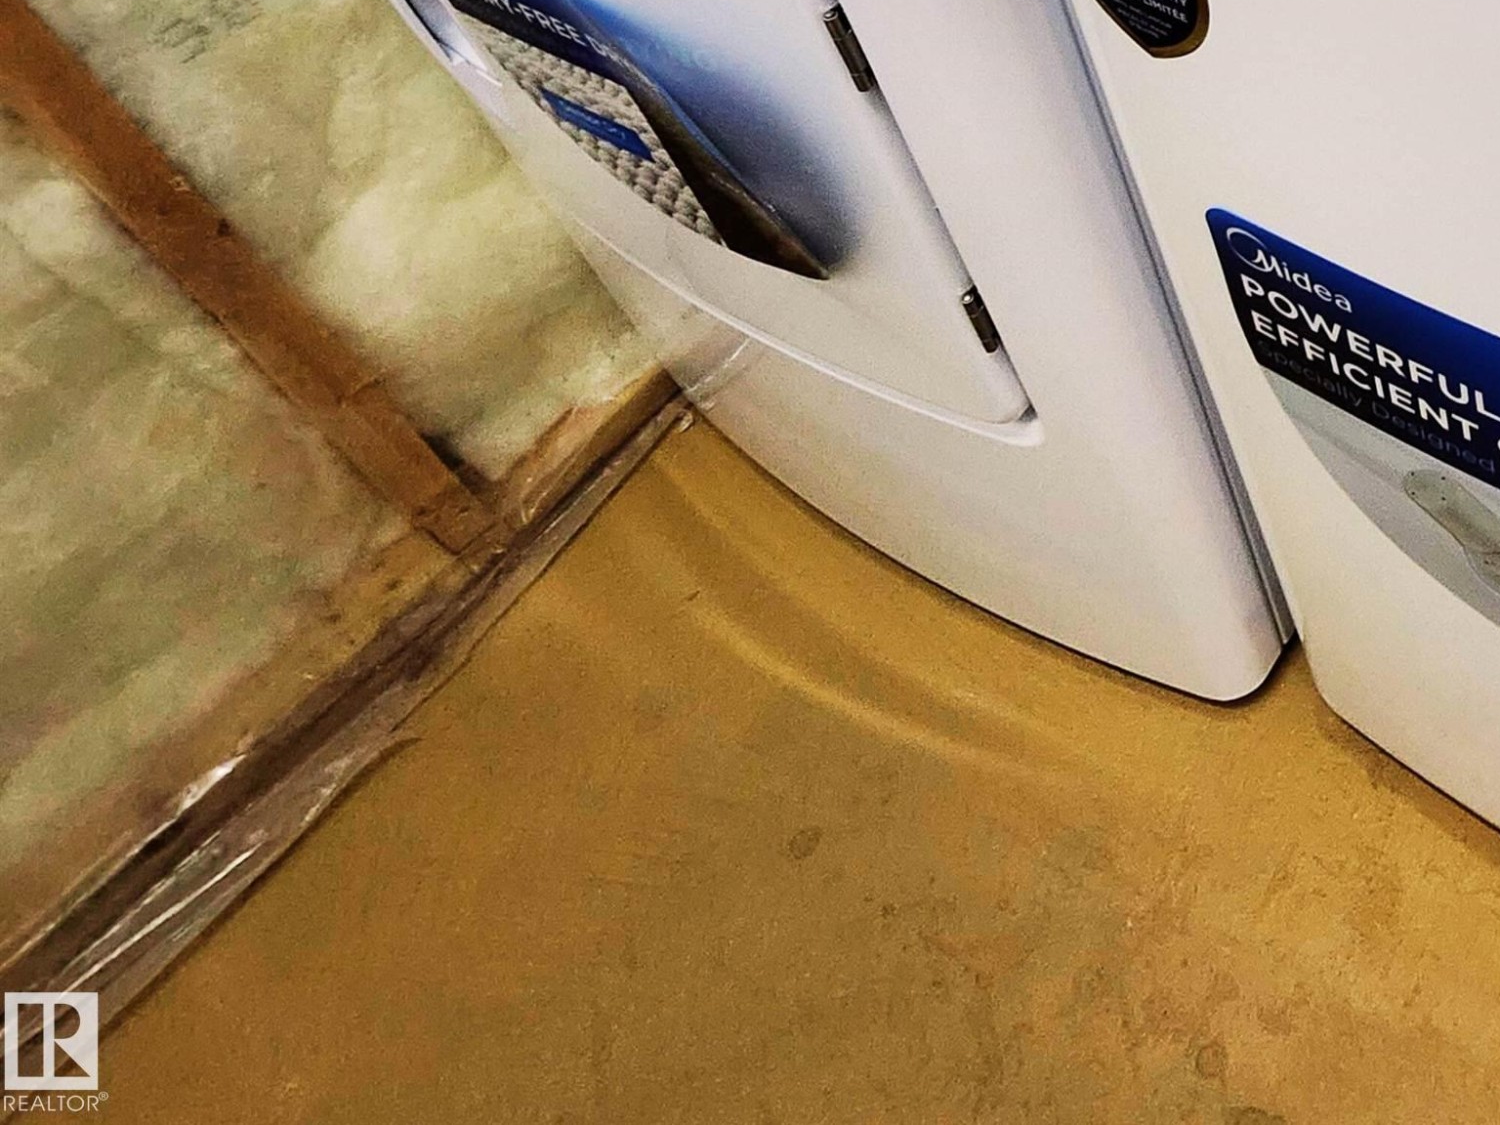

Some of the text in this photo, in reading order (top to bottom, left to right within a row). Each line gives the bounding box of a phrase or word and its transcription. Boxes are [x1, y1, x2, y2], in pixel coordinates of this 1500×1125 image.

[1226, 226, 1354, 314] Midea
[1250, 309, 1480, 442] EFFICIENT
[1371, 400, 1496, 475] Designed
